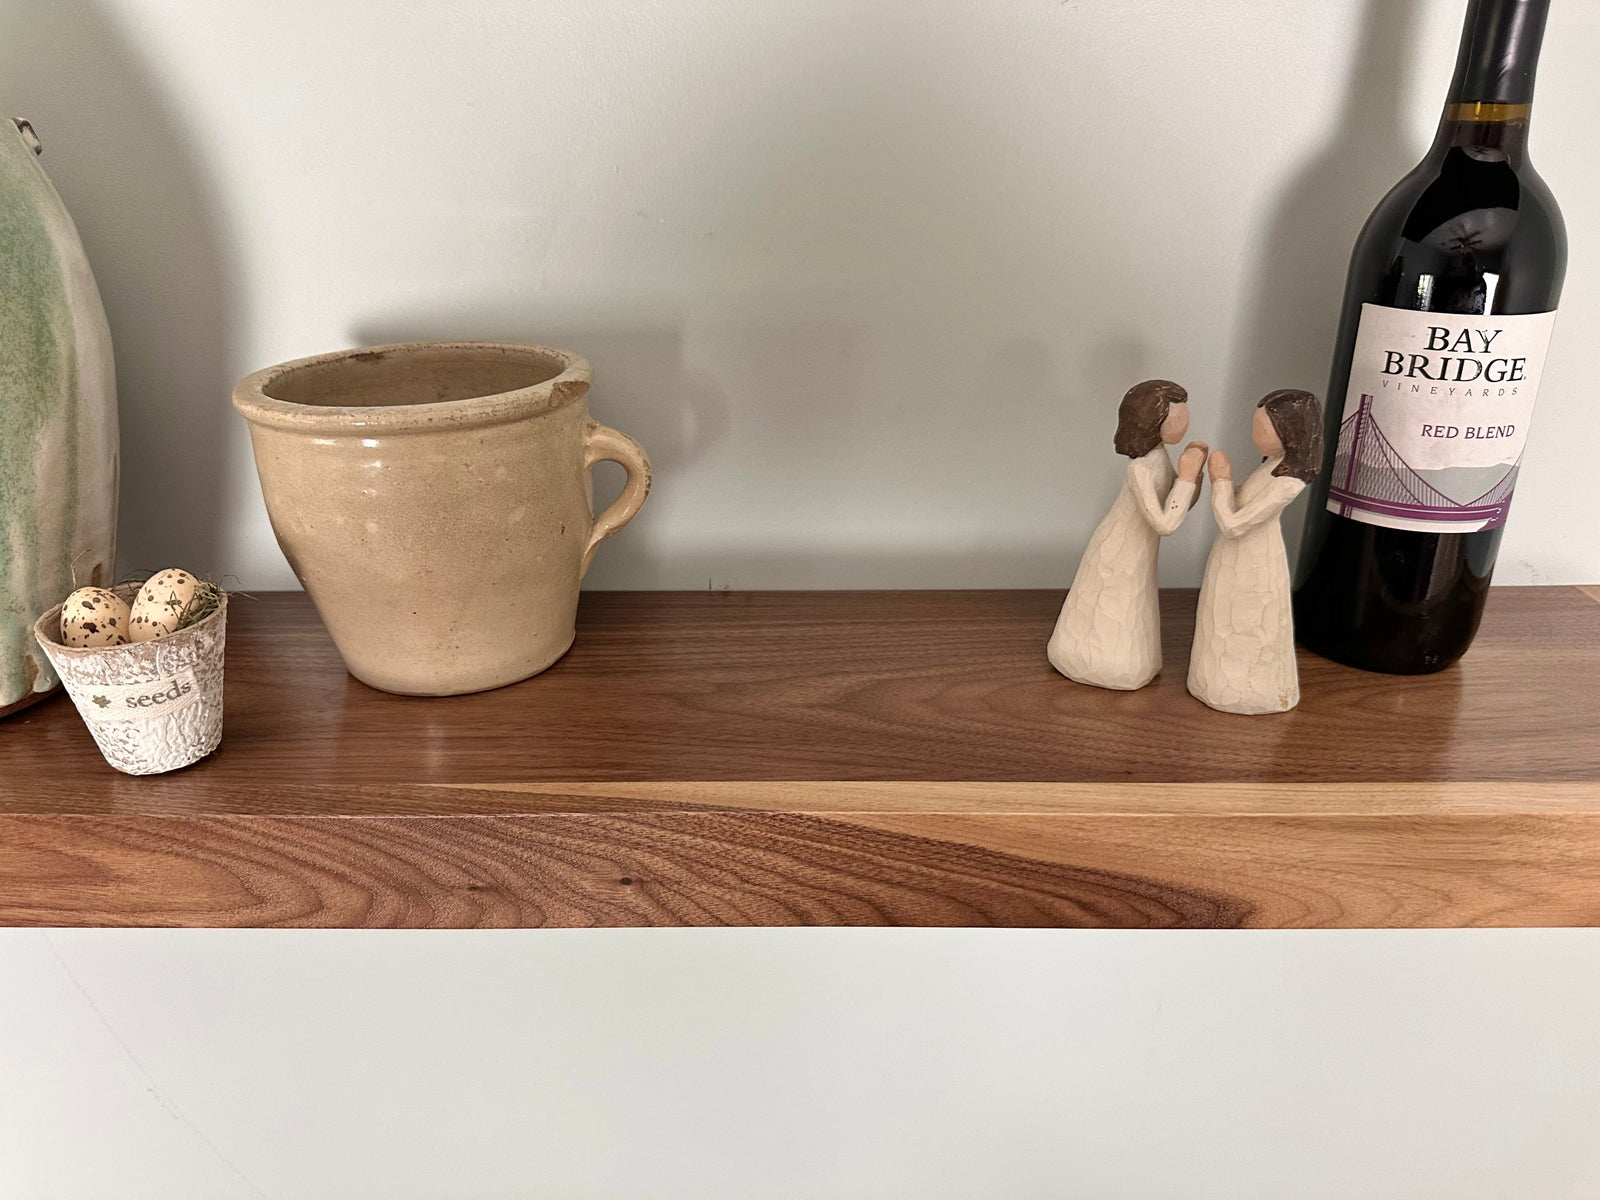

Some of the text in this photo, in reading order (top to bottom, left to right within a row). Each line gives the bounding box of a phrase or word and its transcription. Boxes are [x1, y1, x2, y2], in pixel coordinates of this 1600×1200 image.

[1423, 326, 1503, 354] BAY
[1381, 350, 1525, 383] BRIDGE
[1382, 380, 1519, 397] VINEYARDS
[1420, 424, 1515, 440] RED BLEND
[125, 679, 192, 709] seeds
